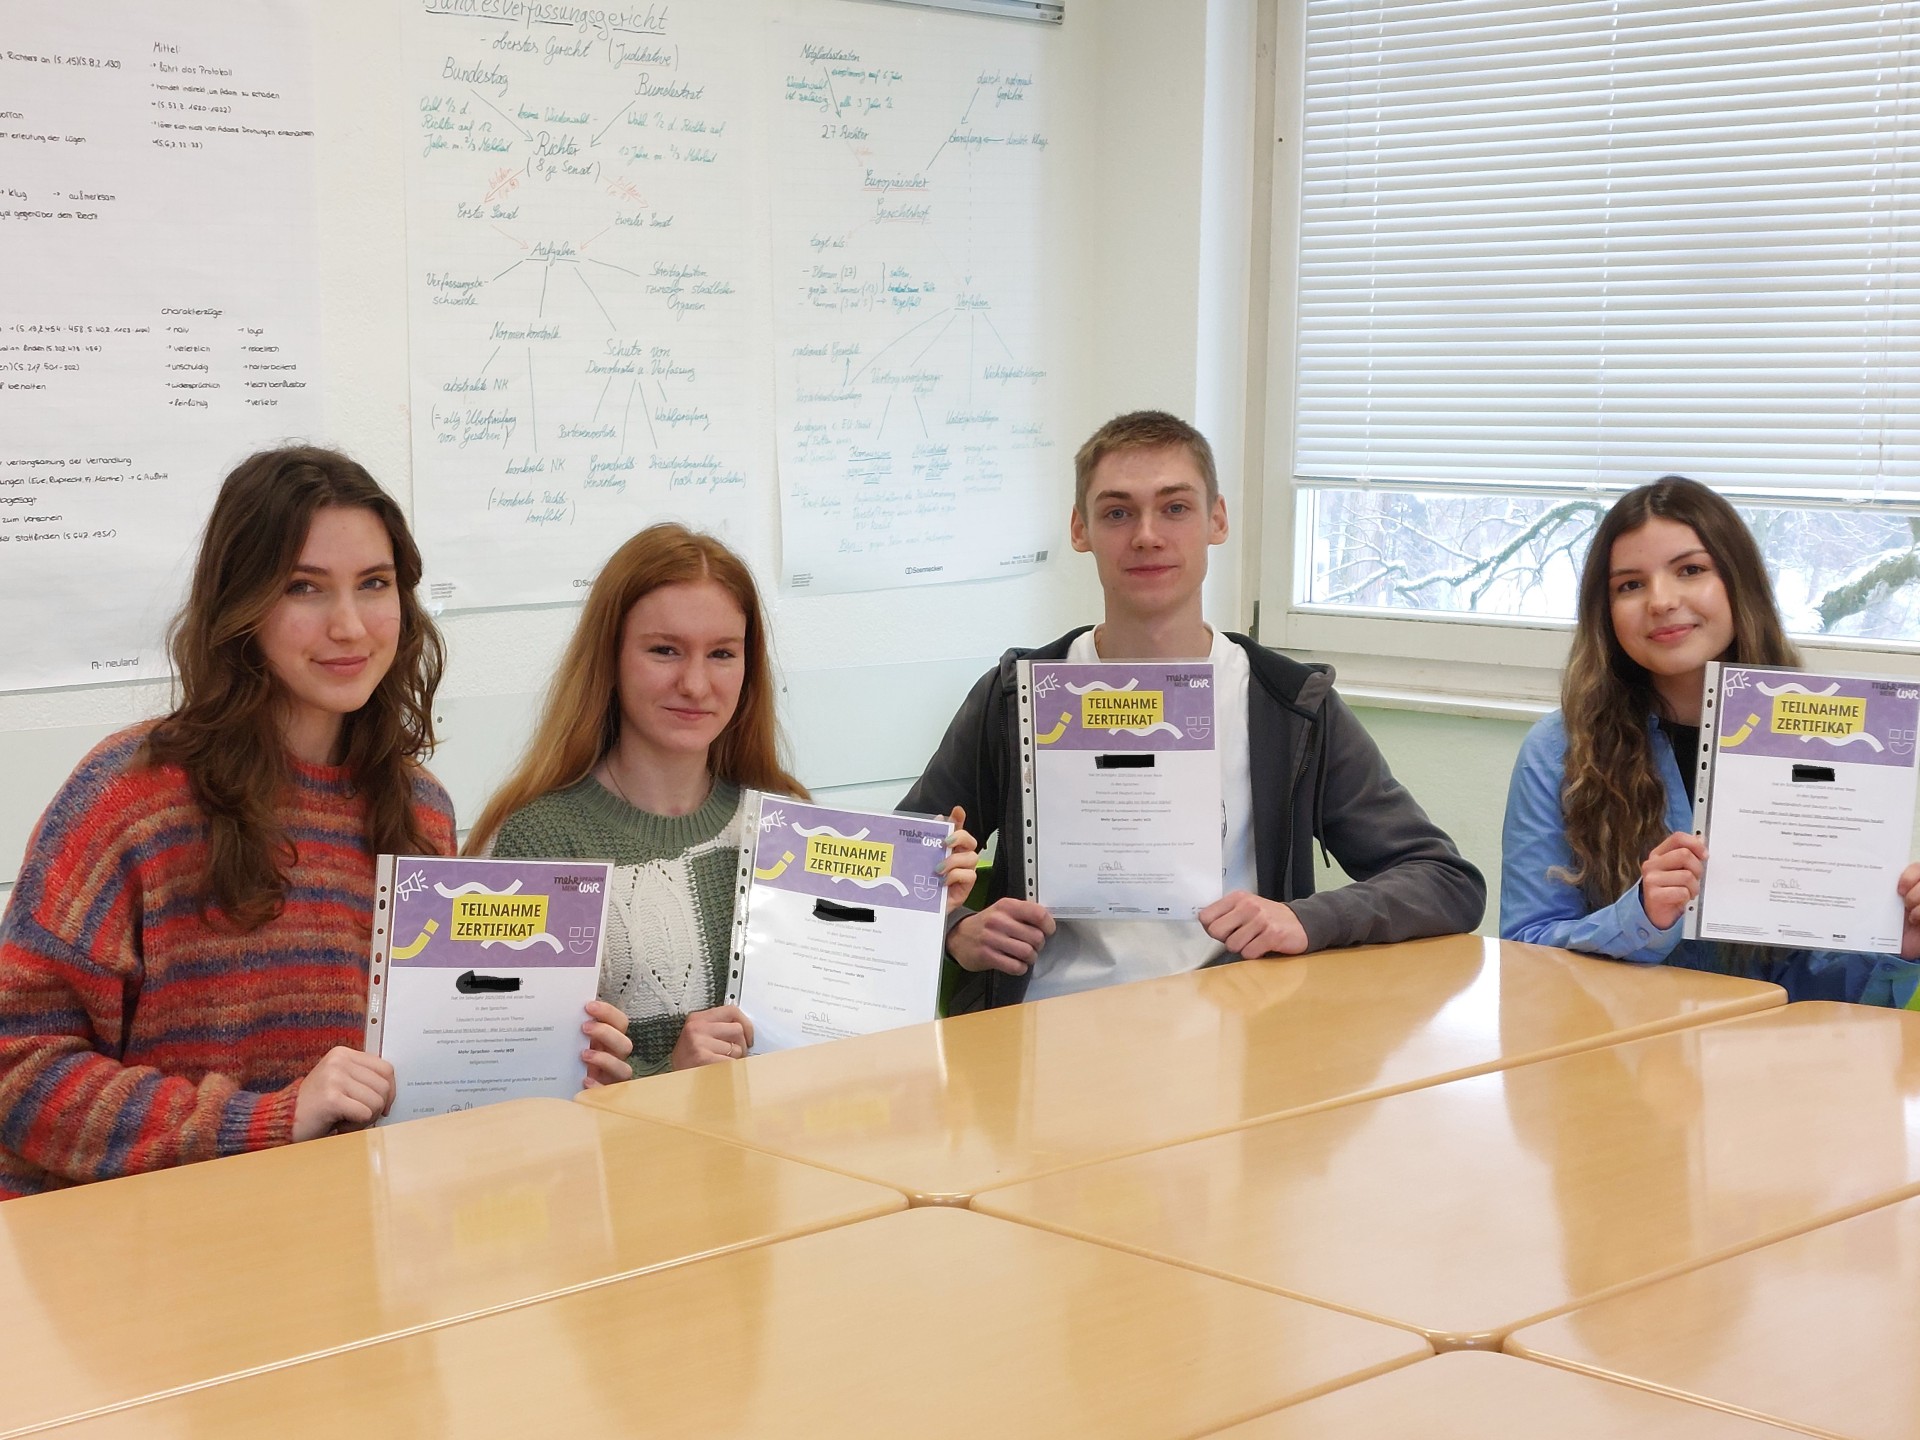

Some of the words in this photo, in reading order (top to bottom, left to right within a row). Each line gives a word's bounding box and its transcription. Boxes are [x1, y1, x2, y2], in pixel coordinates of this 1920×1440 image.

[492, 31, 540, 56] oberstes
[544, 37, 592, 66] Gericht
[182, 66, 197, 75] das
[199, 65, 233, 77] Protokoll
[442, 56, 509, 98] Bundestag
[421, 114, 455, 132] Richter
[458, 119, 475, 138] auf
[820, 124, 837, 141] 27
[533, 130, 581, 156] Richter
[864, 168, 931, 193] Europäischer
[68, 190, 116, 201] aufmerksam
[13, 211, 54, 221] gegenüber
[57, 211, 73, 219] dem
[456, 202, 485, 221] Erster
[489, 205, 521, 221] Senat
[649, 214, 675, 230] Senat
[530, 241, 577, 267] Aufgaben
[246, 327, 264, 337] loyal
[603, 338, 643, 358] Schutz
[650, 345, 672, 359] von
[172, 362, 209, 374] unschuldig
[651, 358, 696, 384] Verfassung
[8, 381, 47, 390] behalten
[442, 376, 488, 394] abstrakte
[494, 378, 509, 394] NK
[250, 398, 279, 406] verliebt
[437, 432, 456, 444] von
[6, 458, 66, 468] verlangsamung
[550, 458, 567, 474] NK
[15, 532, 60, 542] stattfinden
[1087, 697, 1158, 710] TEILNAHME
[1780, 700, 1859, 718] TEILNAHME
[1087, 714, 1154, 726] ZERTIFIKAT
[1777, 718, 1854, 735] ZERTIFIKAT
[814, 841, 887, 863] TEILNAHME
[810, 858, 881, 878] ZERTIFIKAT
[460, 902, 542, 918] TEILNAHME
[456, 922, 535, 938] ZERTIFIKAT
